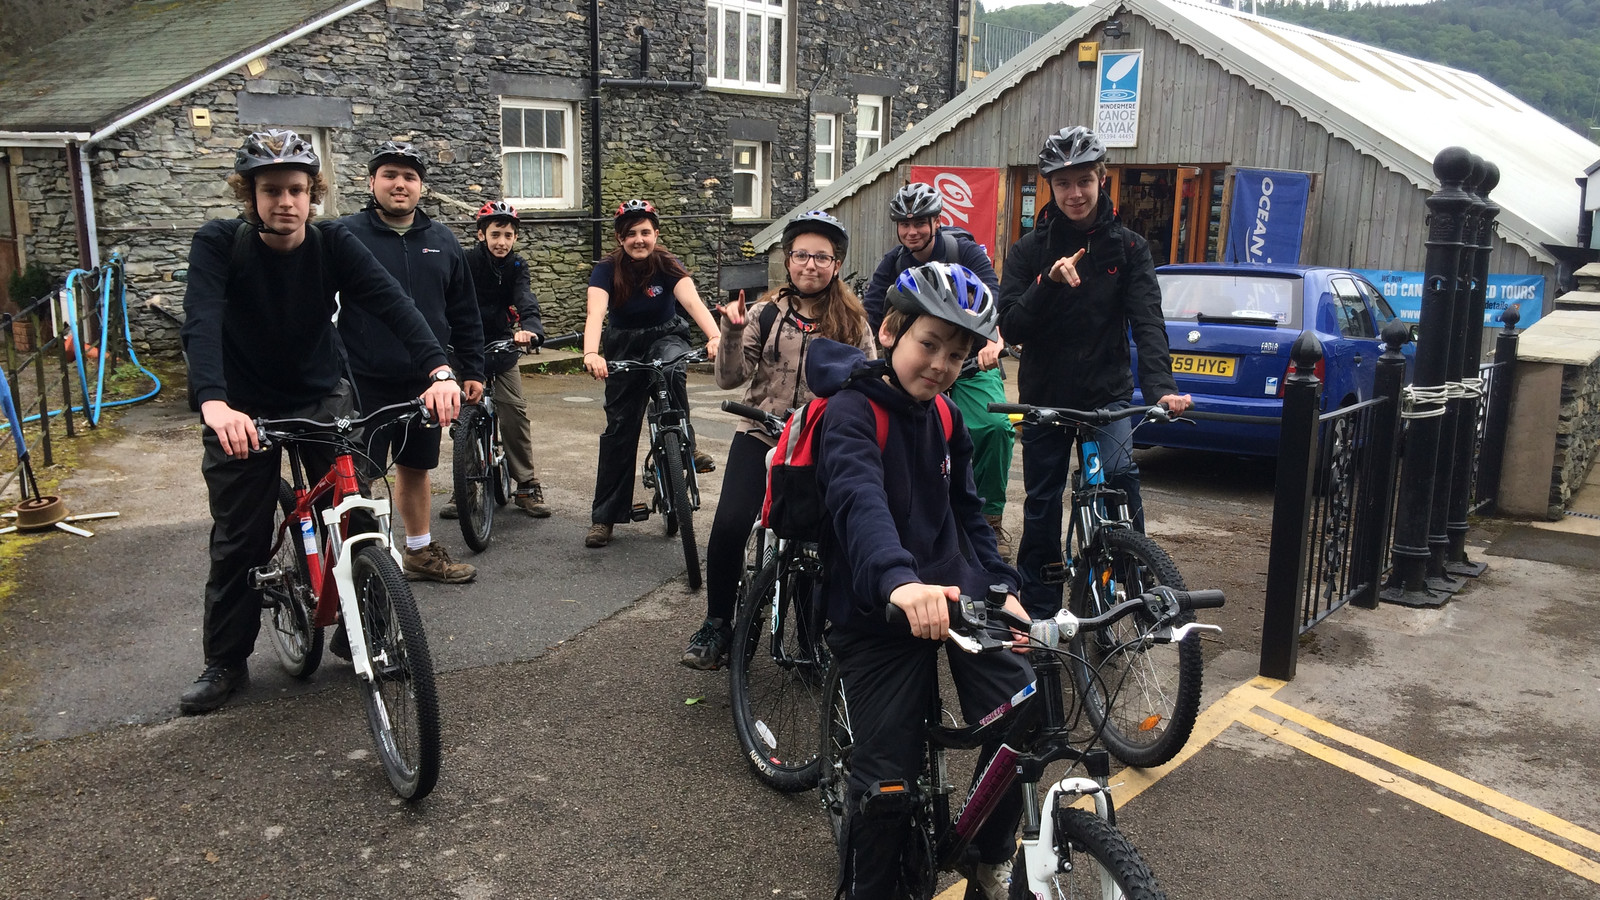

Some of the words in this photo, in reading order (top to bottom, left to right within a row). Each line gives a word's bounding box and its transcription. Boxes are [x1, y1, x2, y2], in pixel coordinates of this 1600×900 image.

[1098, 110, 1136, 121] CANOE
[1098, 122, 1134, 133] KAYAK
[1250, 176, 1274, 257] OCEAN
[1383, 282, 1398, 297] GO
[1400, 283, 1424, 298] CAN
[1501, 285, 1536, 300] TOURS
[1171, 357, 1193, 371] 59
[1196, 359, 1227, 374] HYG
[749, 749, 767, 771] NANO
